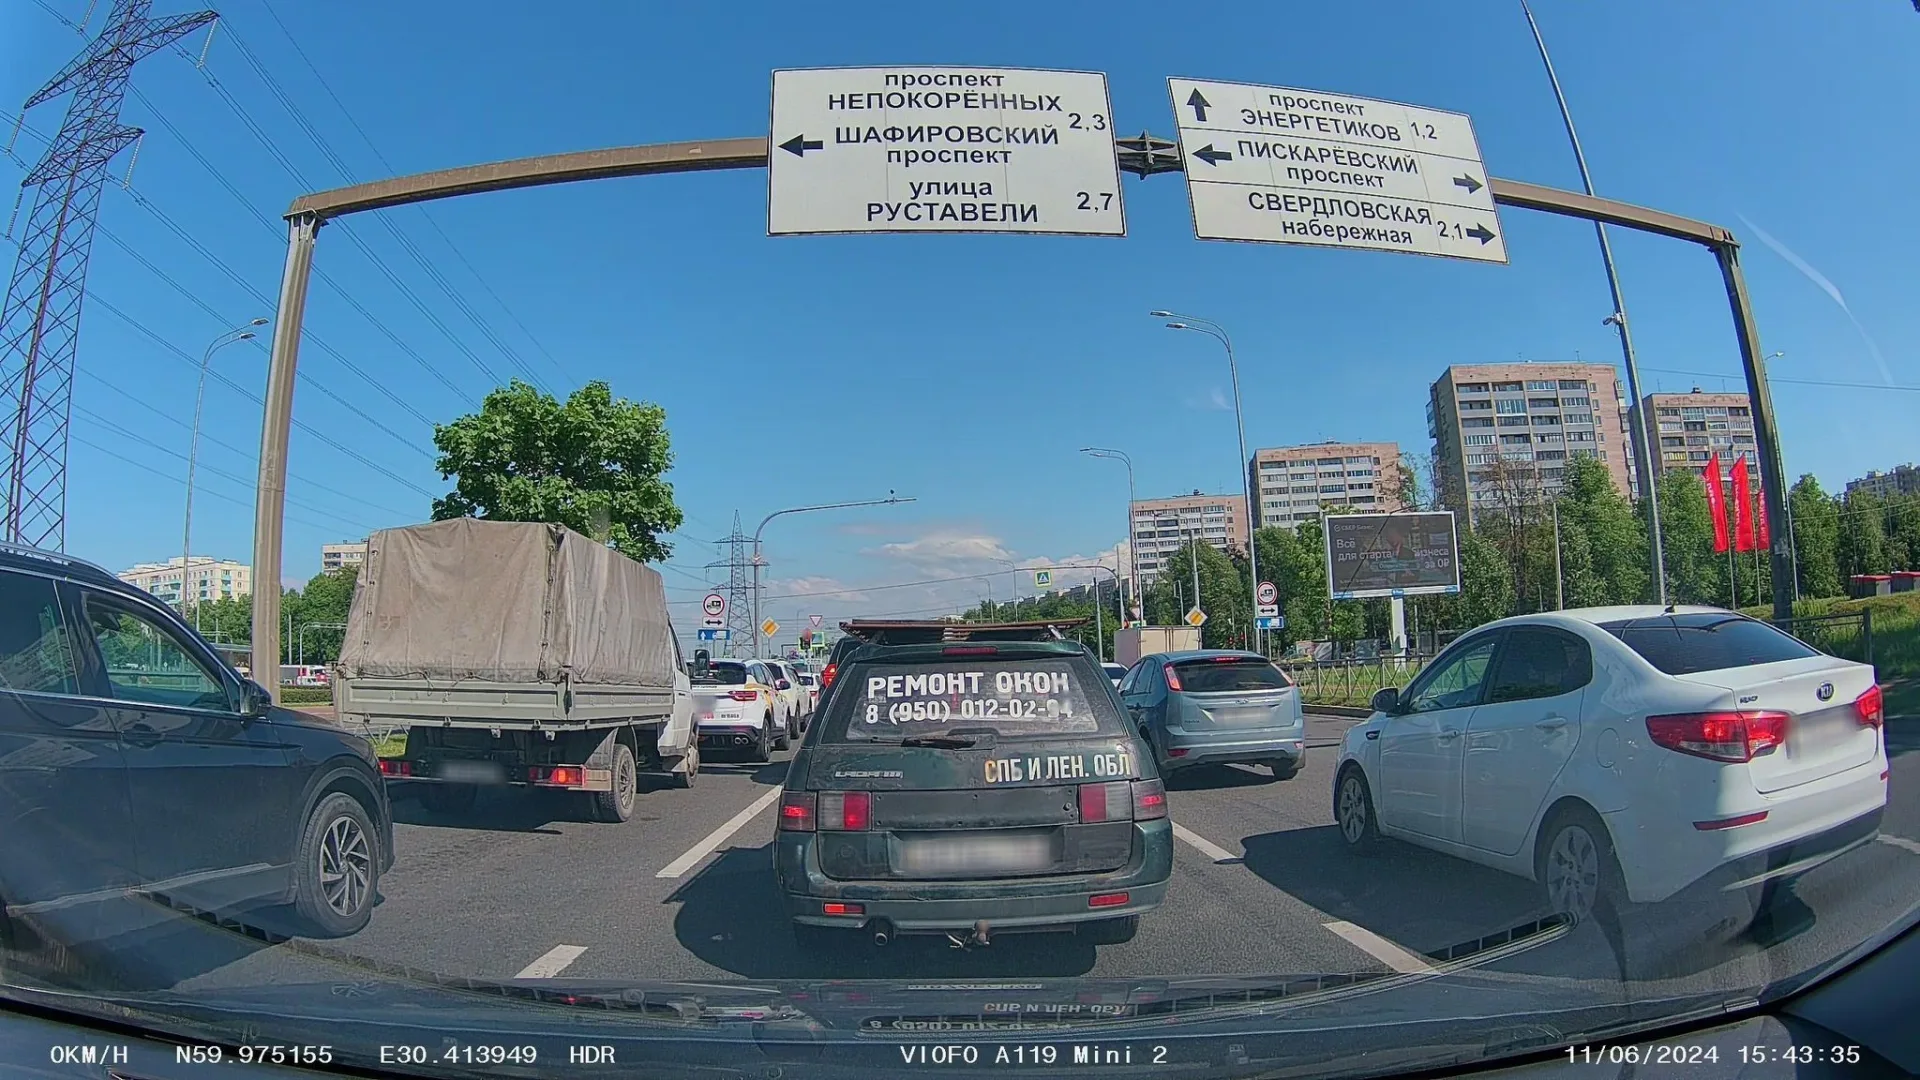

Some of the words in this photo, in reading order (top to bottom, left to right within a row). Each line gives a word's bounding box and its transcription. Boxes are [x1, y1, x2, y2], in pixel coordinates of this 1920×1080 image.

[885, 74, 1005, 90] проспект
[828, 90, 1063, 112] НЕПОКОРЁННЫХ
[1269, 94, 1365, 116] проспект
[1068, 112, 1107, 132] 2,3
[1240, 108, 1401, 141] ЭНЕРГЕТИКОВ
[1410, 121, 1438, 140] 1,2
[835, 125, 1059, 145] ШАФИРОВСКИЙ
[887, 149, 1012, 167] проспект
[1237, 140, 1419, 174] ПИСКАРЁВСКИЙ
[1287, 165, 1385, 188] проспект
[909, 180, 993, 199] улица
[867, 202, 1038, 223] РУСТАВЕЛИ
[1076, 192, 1114, 213] 2,7
[1248, 191, 1432, 225] СВЕРДЛОВСКАЯ
[1282, 219, 1413, 244] набережная
[1437, 220, 1463, 241] 2,1
[1336, 538, 1356, 549] Всё
[1338, 552, 1357, 562] для
[867, 671, 984, 699] РЕМОНТ
[996, 671, 1070, 694] ОКОН
[865, 704, 879, 724] 8
[889, 700, 950, 726] (950)
[984, 758, 1023, 783] СПБ
[1028, 757, 1041, 780] И
[1046, 755, 1090, 780] ЛЕН.
[1093, 754, 1131, 777] ОБЛ
